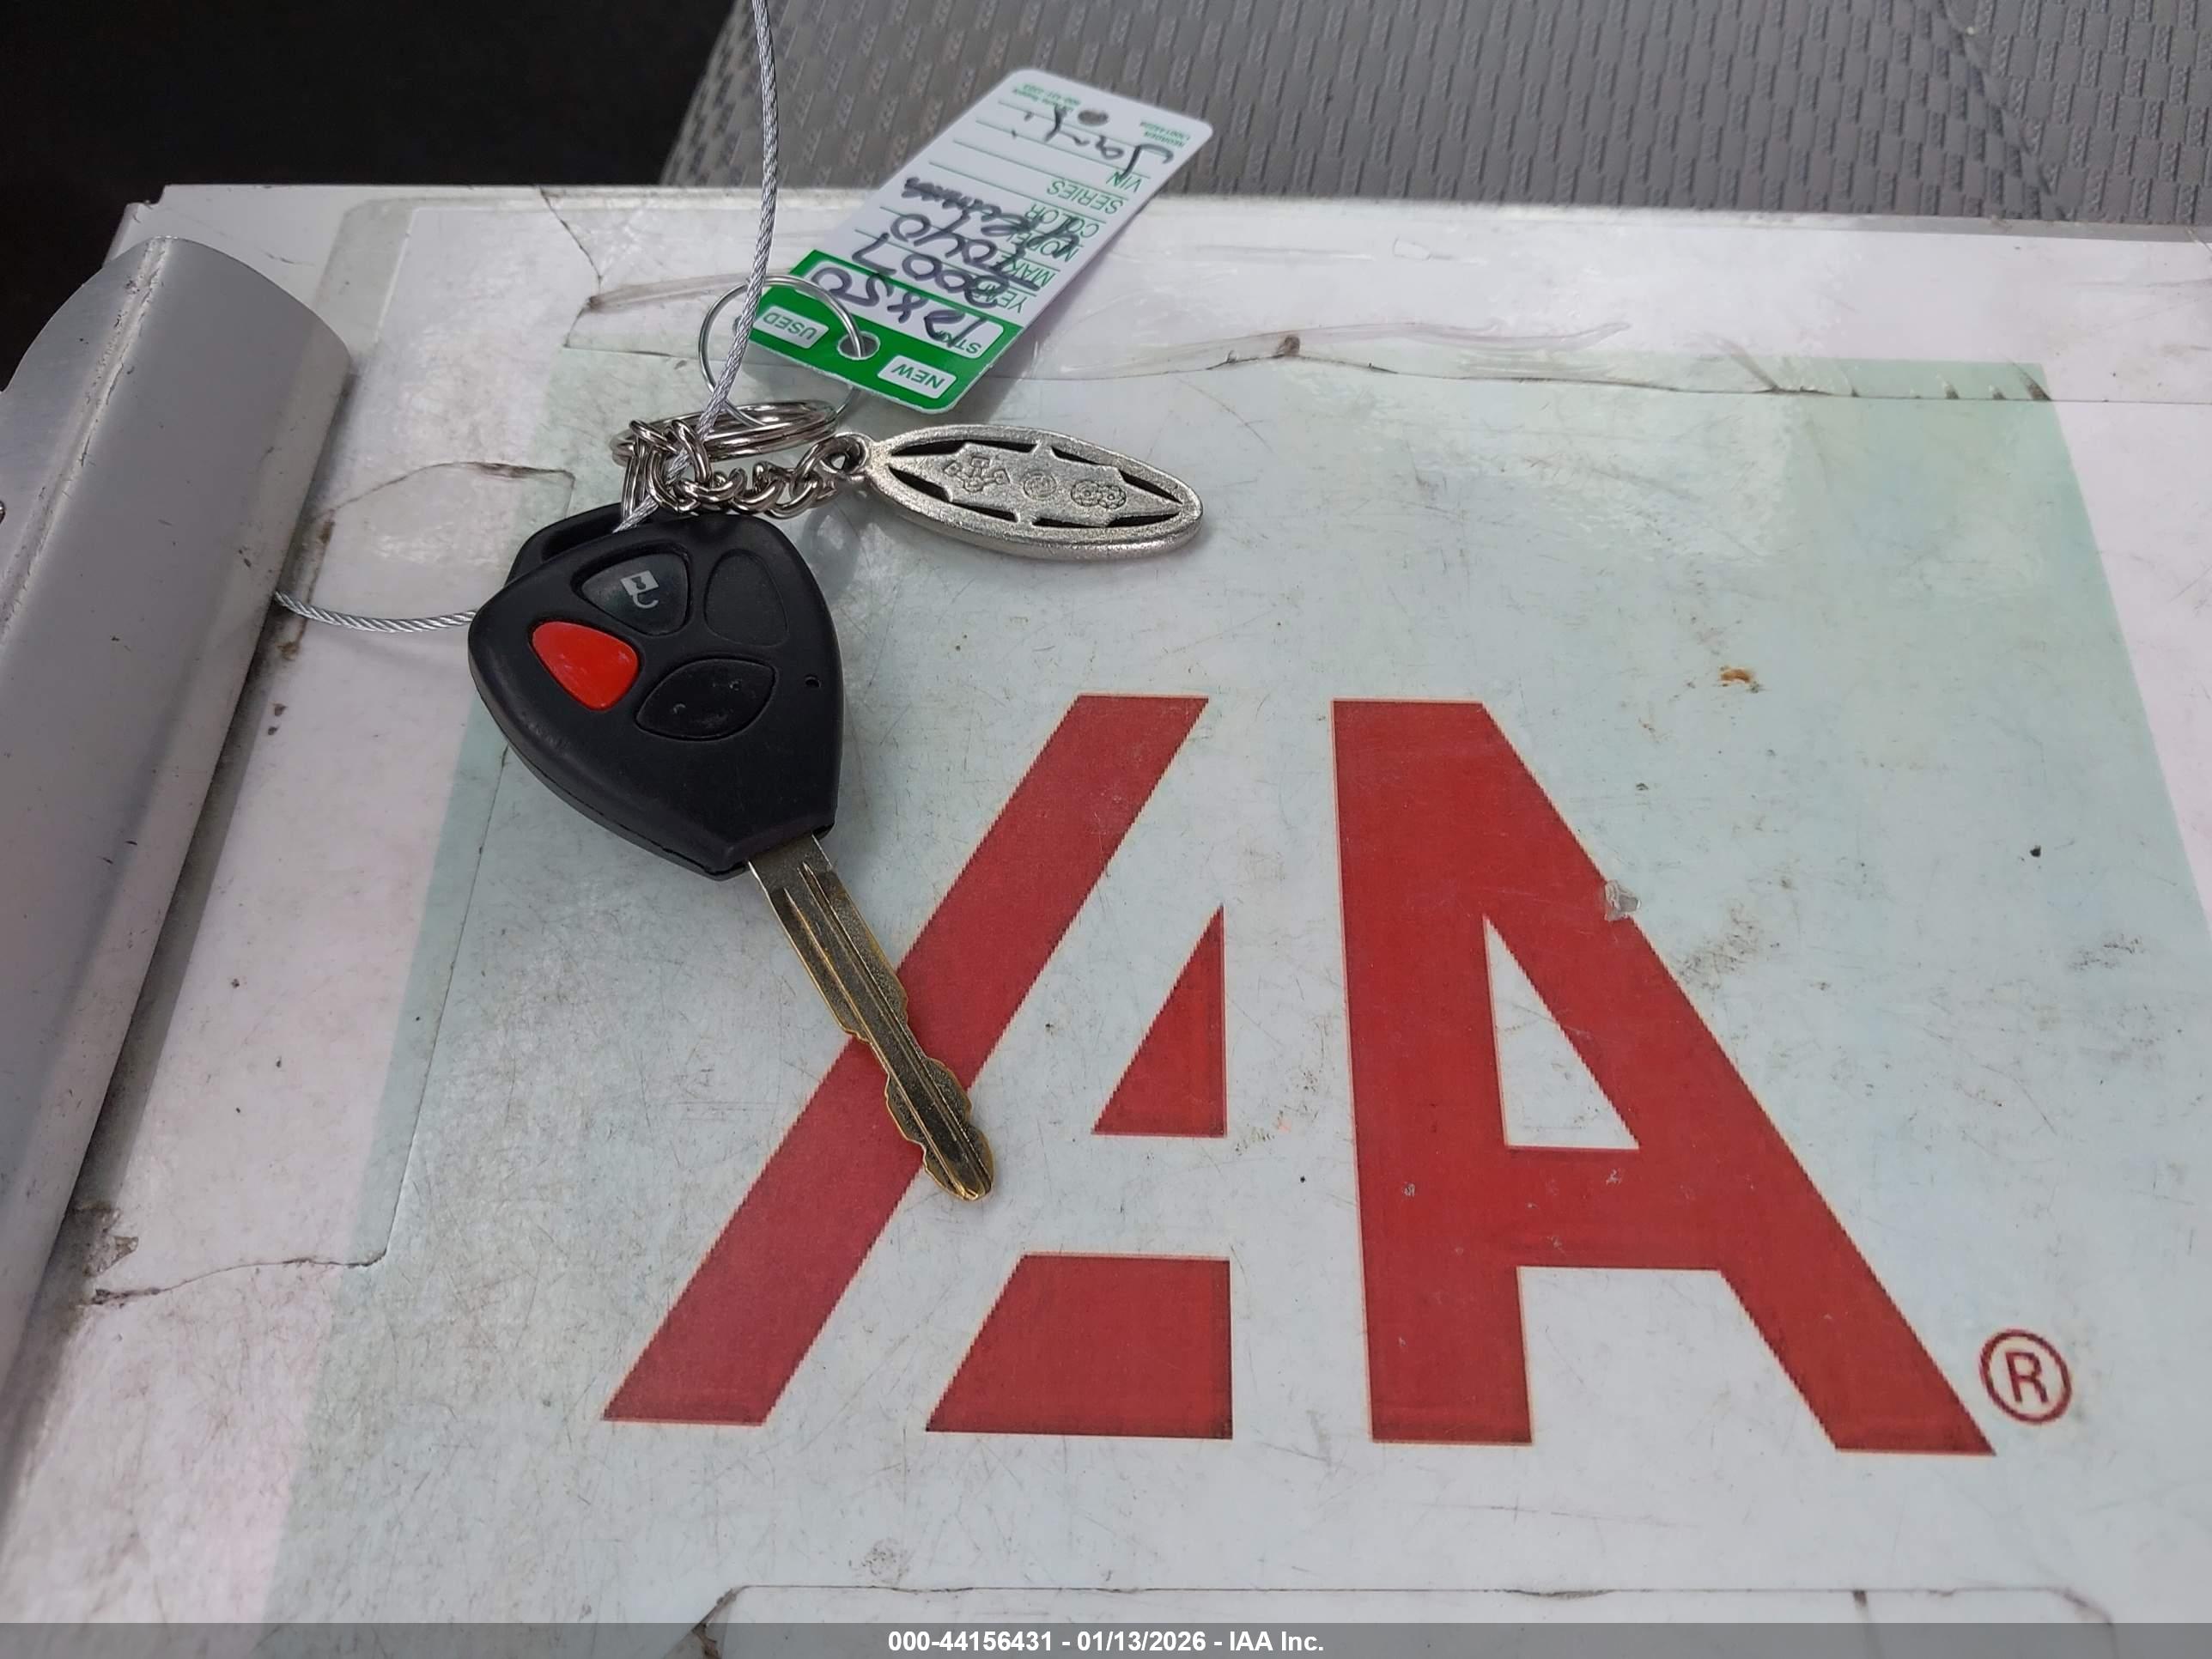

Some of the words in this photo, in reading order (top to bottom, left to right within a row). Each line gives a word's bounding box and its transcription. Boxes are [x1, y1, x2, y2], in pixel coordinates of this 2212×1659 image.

[1105, 171, 1142, 193] VIN
[1047, 180, 1124, 215] SERIES
[1024, 204, 1100, 238] COLOR
[1006, 233, 1079, 263] MODEL
[763, 311, 820, 341] USED
[890, 362, 945, 389] NEW
